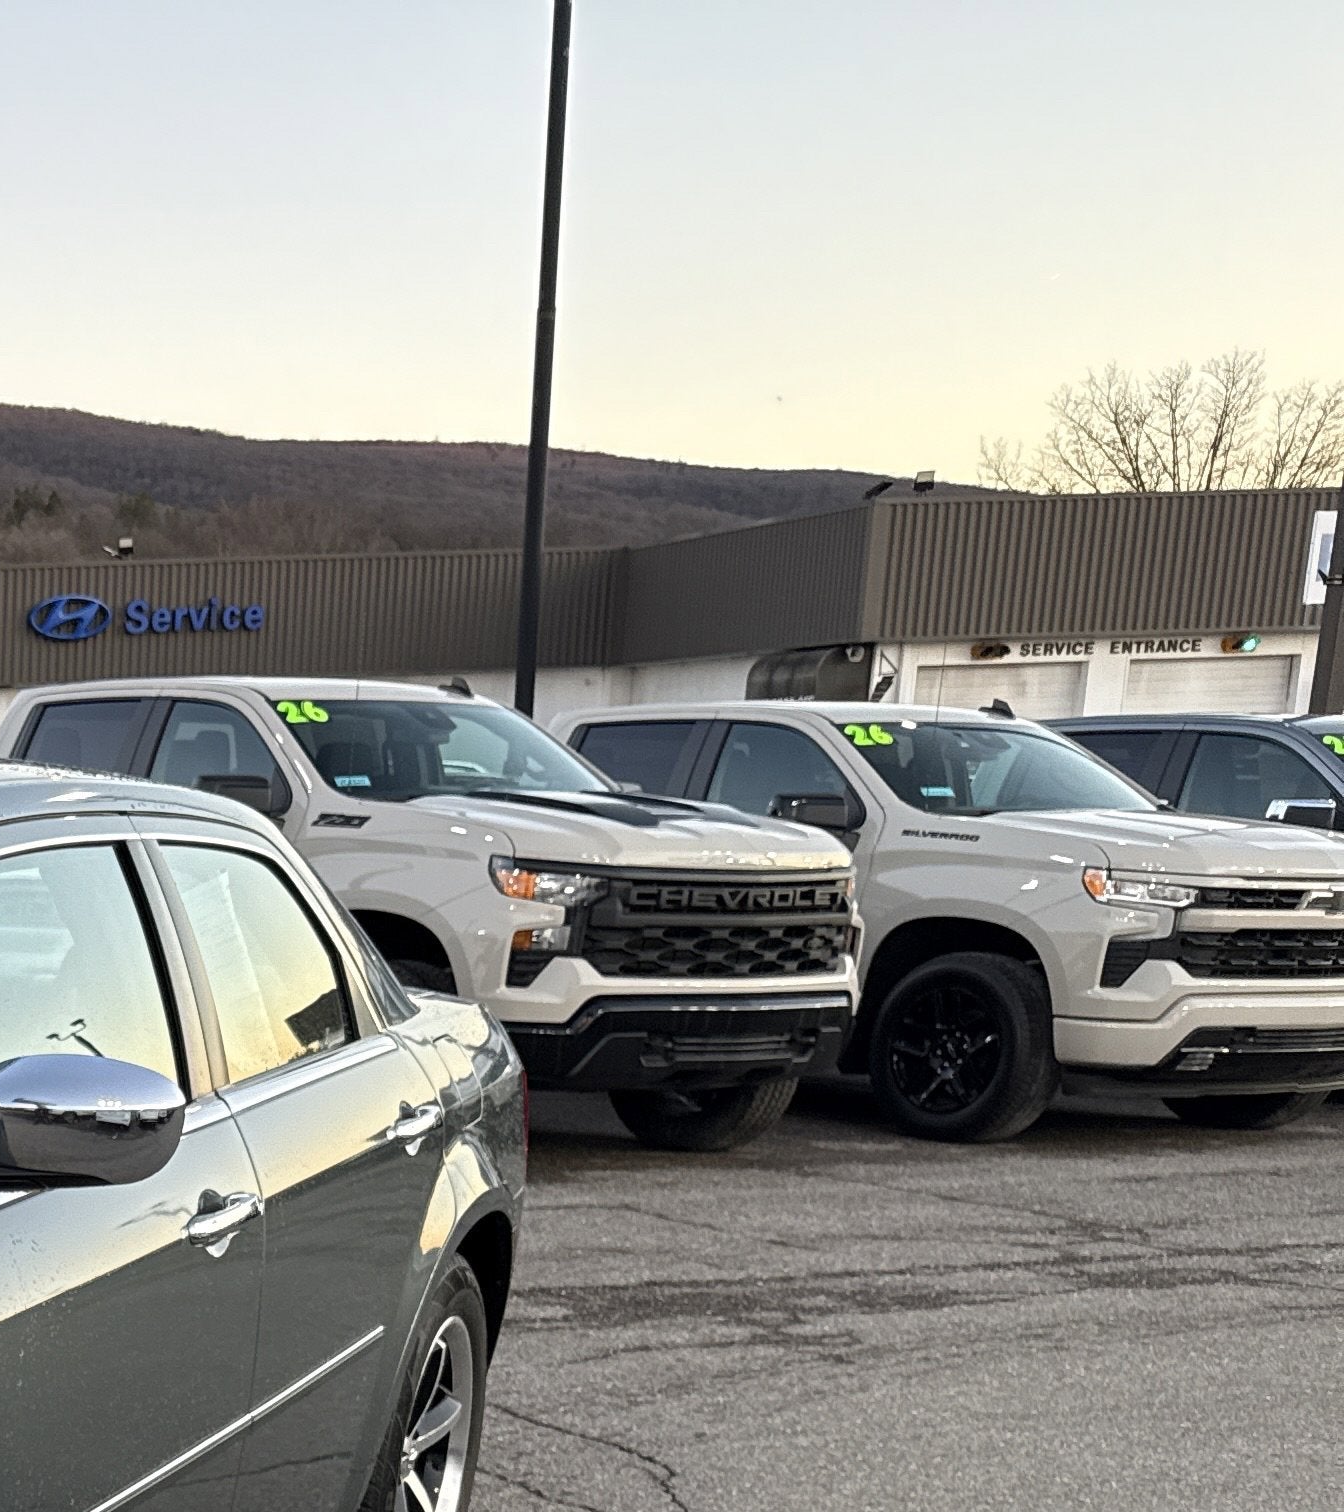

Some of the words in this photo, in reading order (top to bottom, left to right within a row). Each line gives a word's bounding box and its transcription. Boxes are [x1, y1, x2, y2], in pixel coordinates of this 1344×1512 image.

[125, 596, 265, 635] Service
[1019, 640, 1095, 657] SERVICE
[1109, 638, 1202, 655] ENTRANCE
[276, 701, 329, 723] 26
[844, 724, 894, 746] 26
[1322, 735, 1344, 755] 2
[901, 829, 980, 842] SILVERADO
